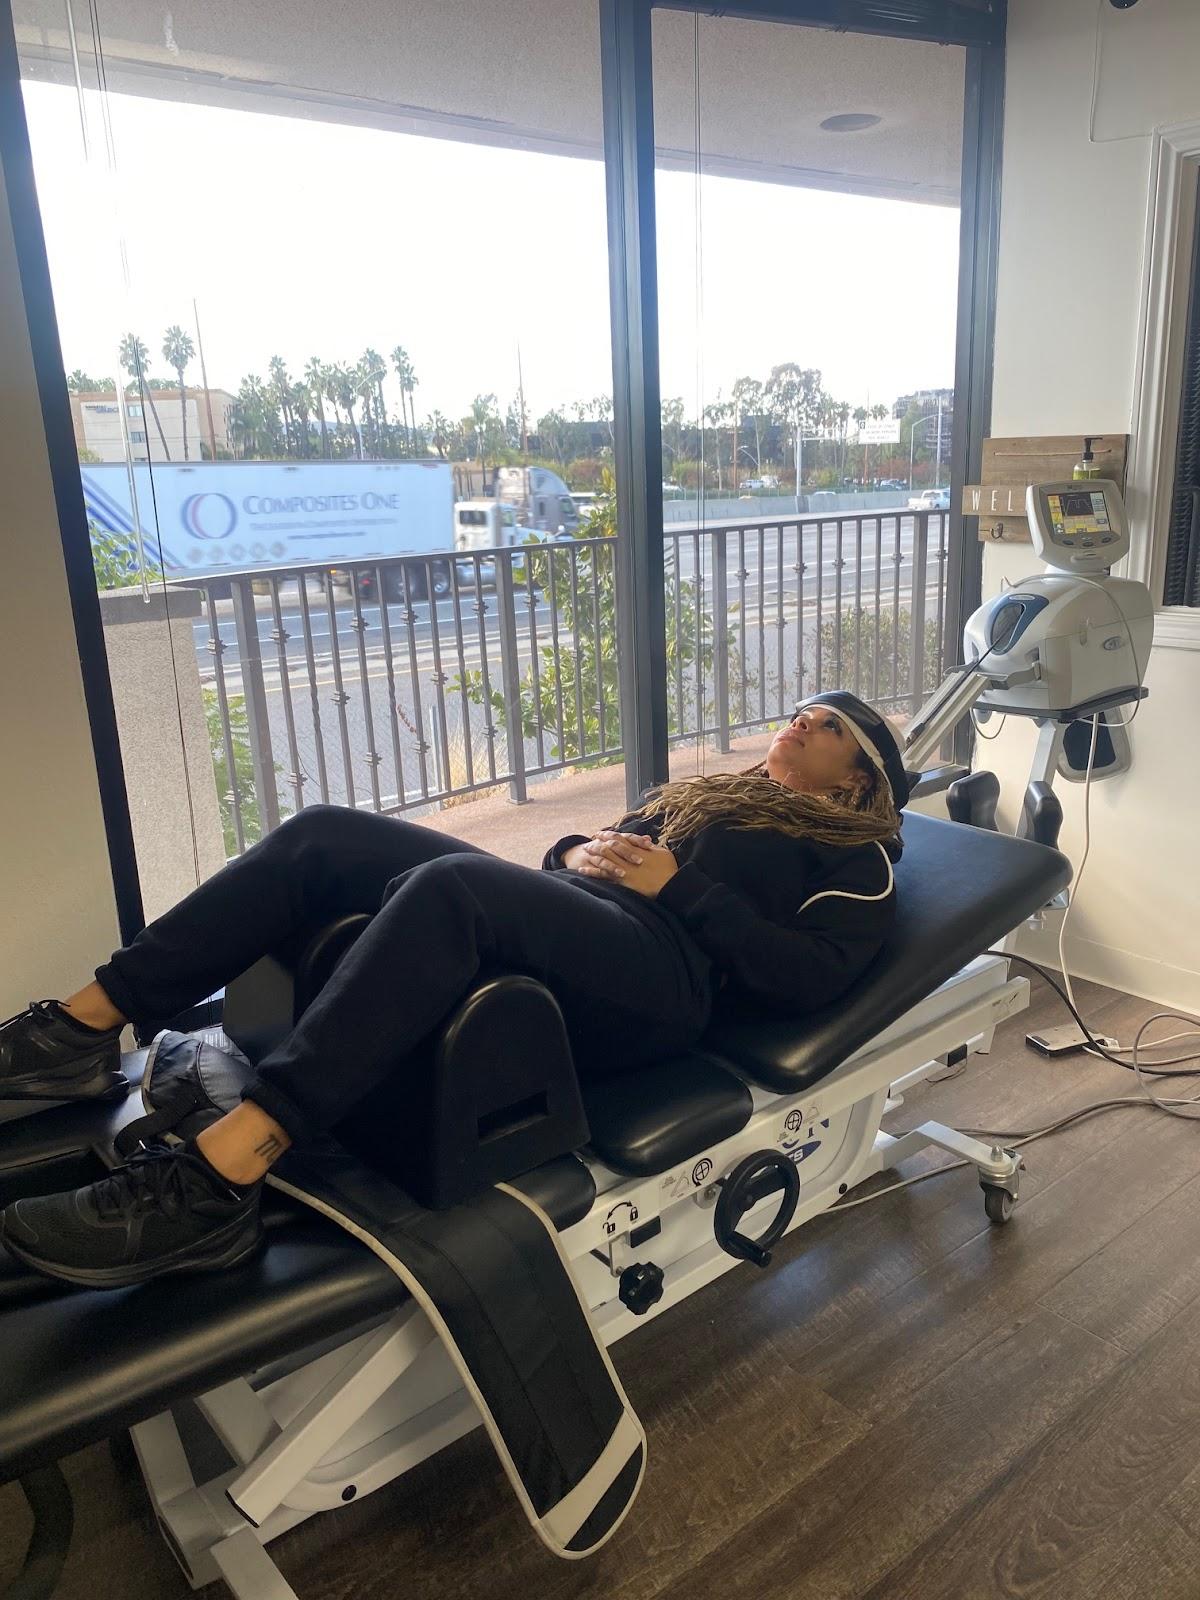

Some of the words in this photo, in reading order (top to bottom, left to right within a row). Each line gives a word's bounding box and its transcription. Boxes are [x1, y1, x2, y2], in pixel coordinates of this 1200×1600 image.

[242, 495, 359, 514] COMPOSITES
[361, 491, 400, 510] ONE
[972, 489, 1014, 511] WEL
